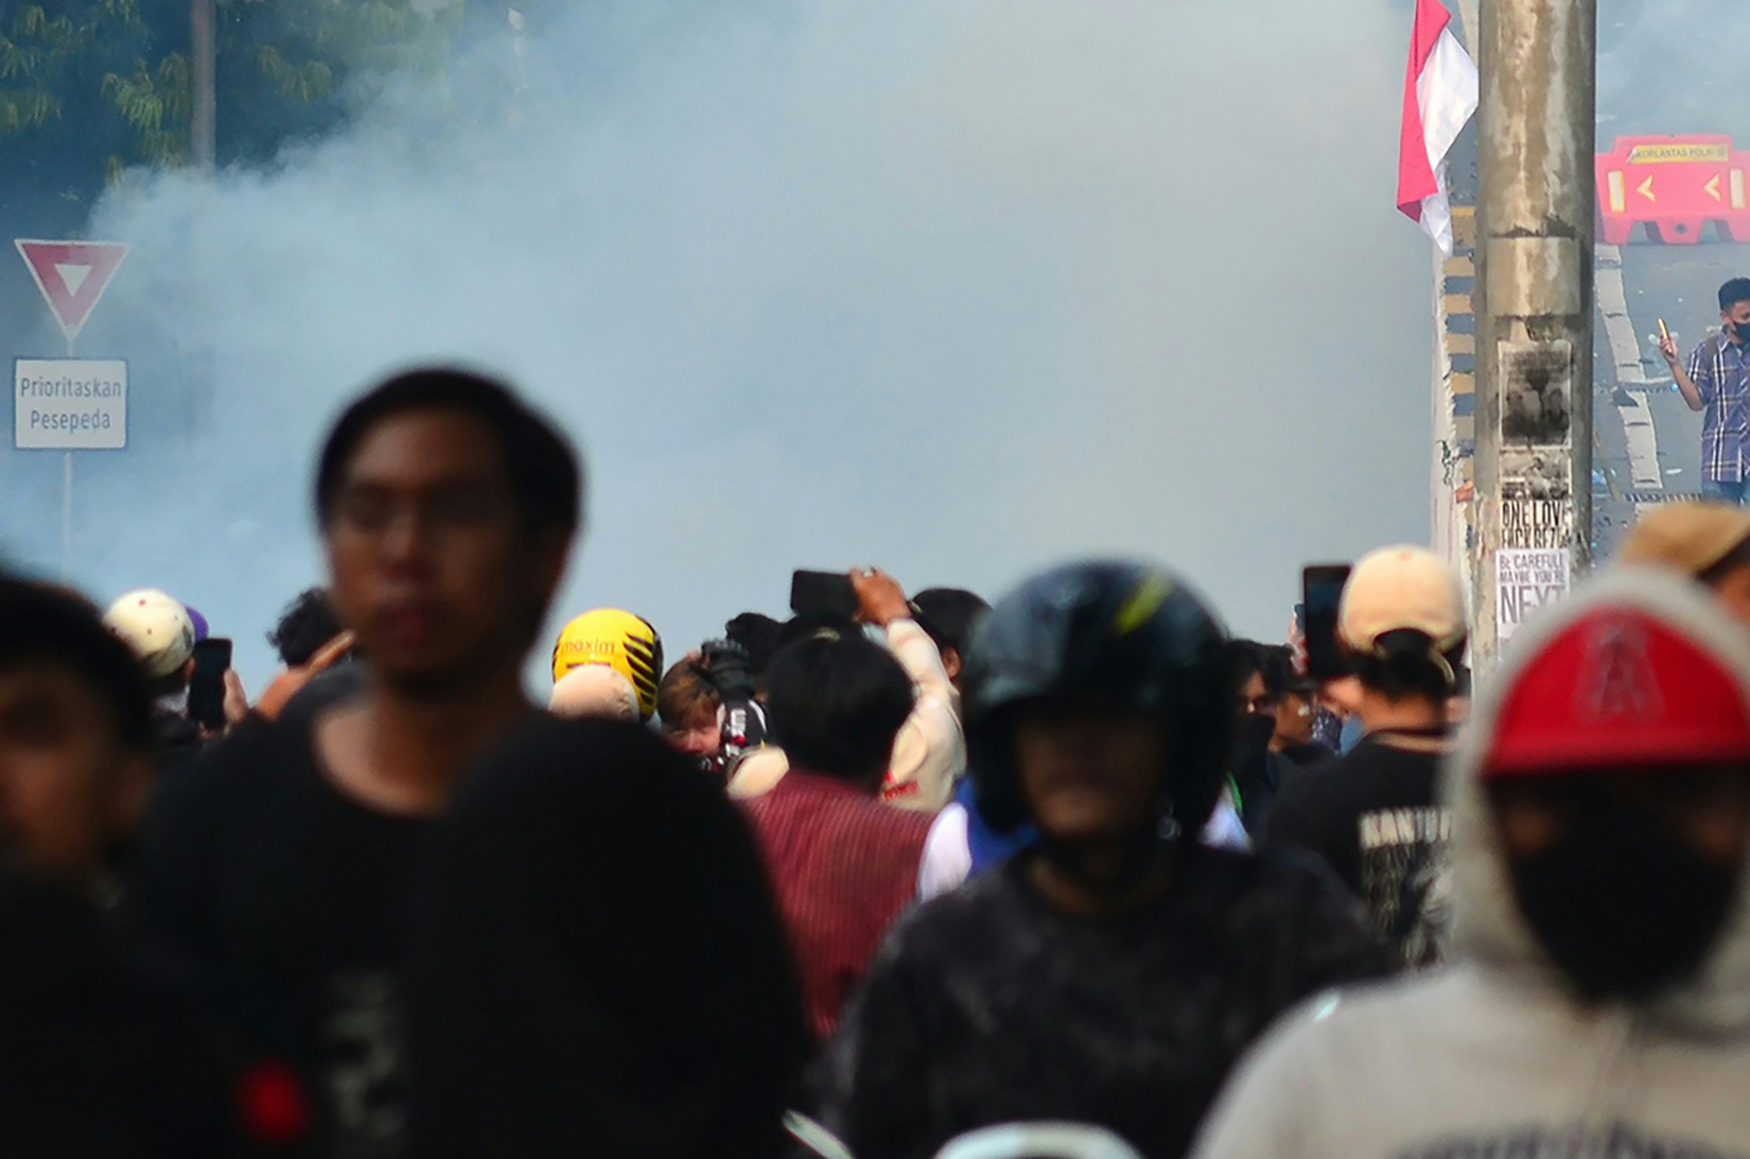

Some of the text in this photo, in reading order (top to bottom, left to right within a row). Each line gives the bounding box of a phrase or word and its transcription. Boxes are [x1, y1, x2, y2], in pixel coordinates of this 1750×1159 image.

[21, 375, 121, 397] Prioritaskan
[31, 408, 110, 434] Pesepeda
[1502, 501, 1529, 527] ONE
